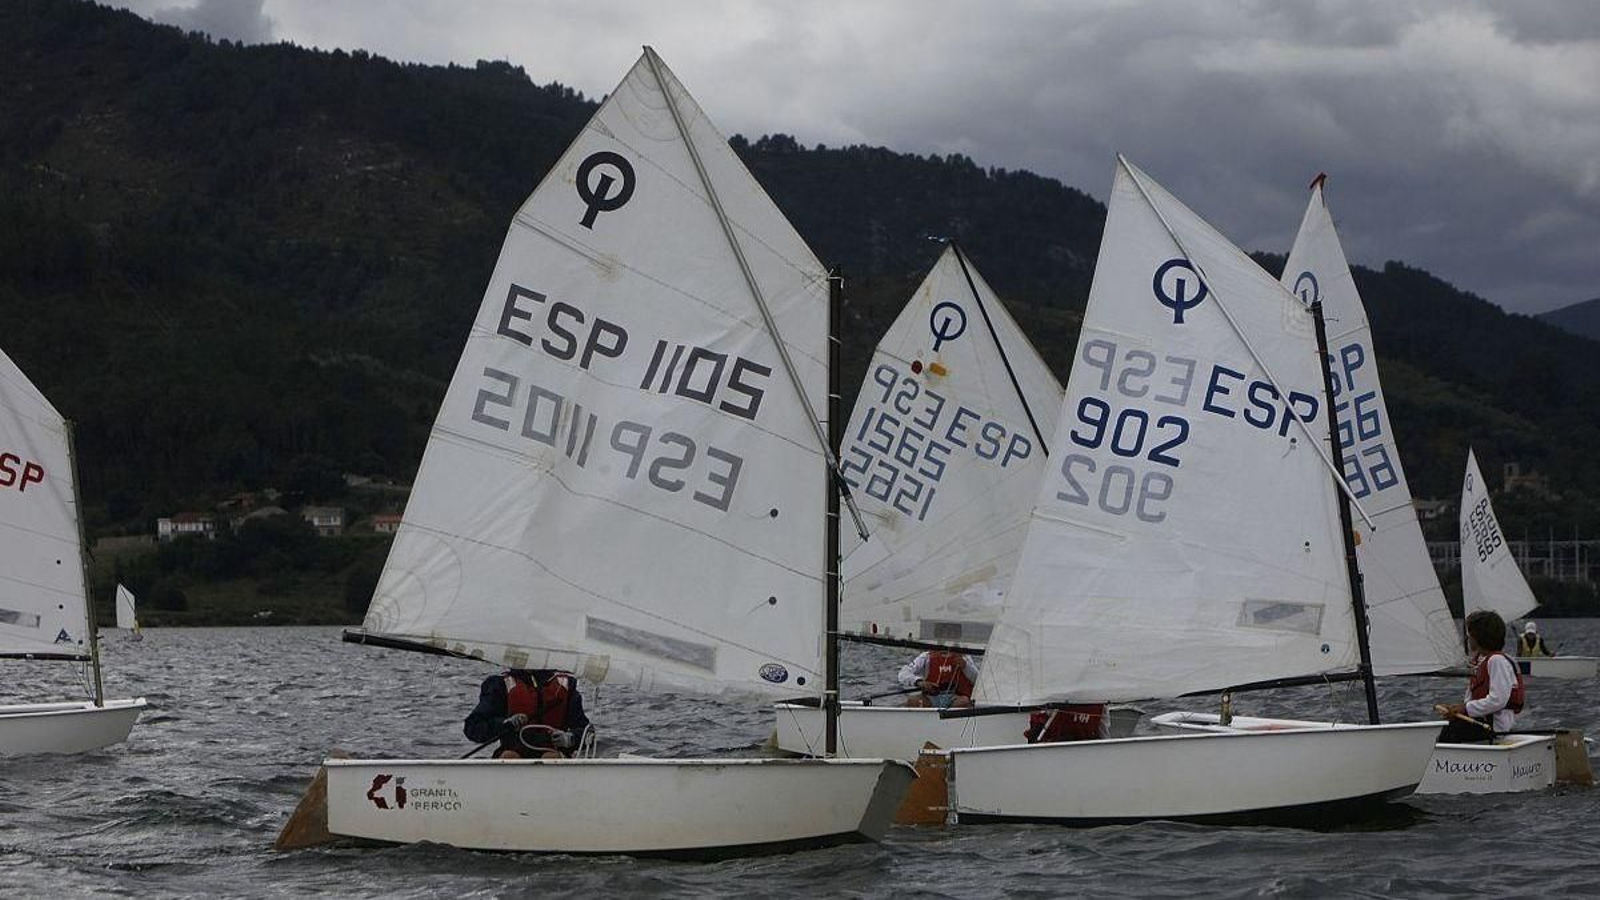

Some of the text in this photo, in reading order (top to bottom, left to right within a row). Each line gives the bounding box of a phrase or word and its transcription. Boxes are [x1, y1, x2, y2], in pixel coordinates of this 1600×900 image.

[497, 283, 772, 420] ESP 1105
[1202, 364, 1320, 437] ESP
[857, 407, 951, 482] 1565
[945, 406, 1032, 468] ESP
[1070, 396, 1190, 468] 902
[1470, 498, 1488, 529] ESP
[1478, 529, 1502, 562] 565
[1435, 759, 1498, 773] Mauro
[1512, 763, 1542, 779] Mauro
